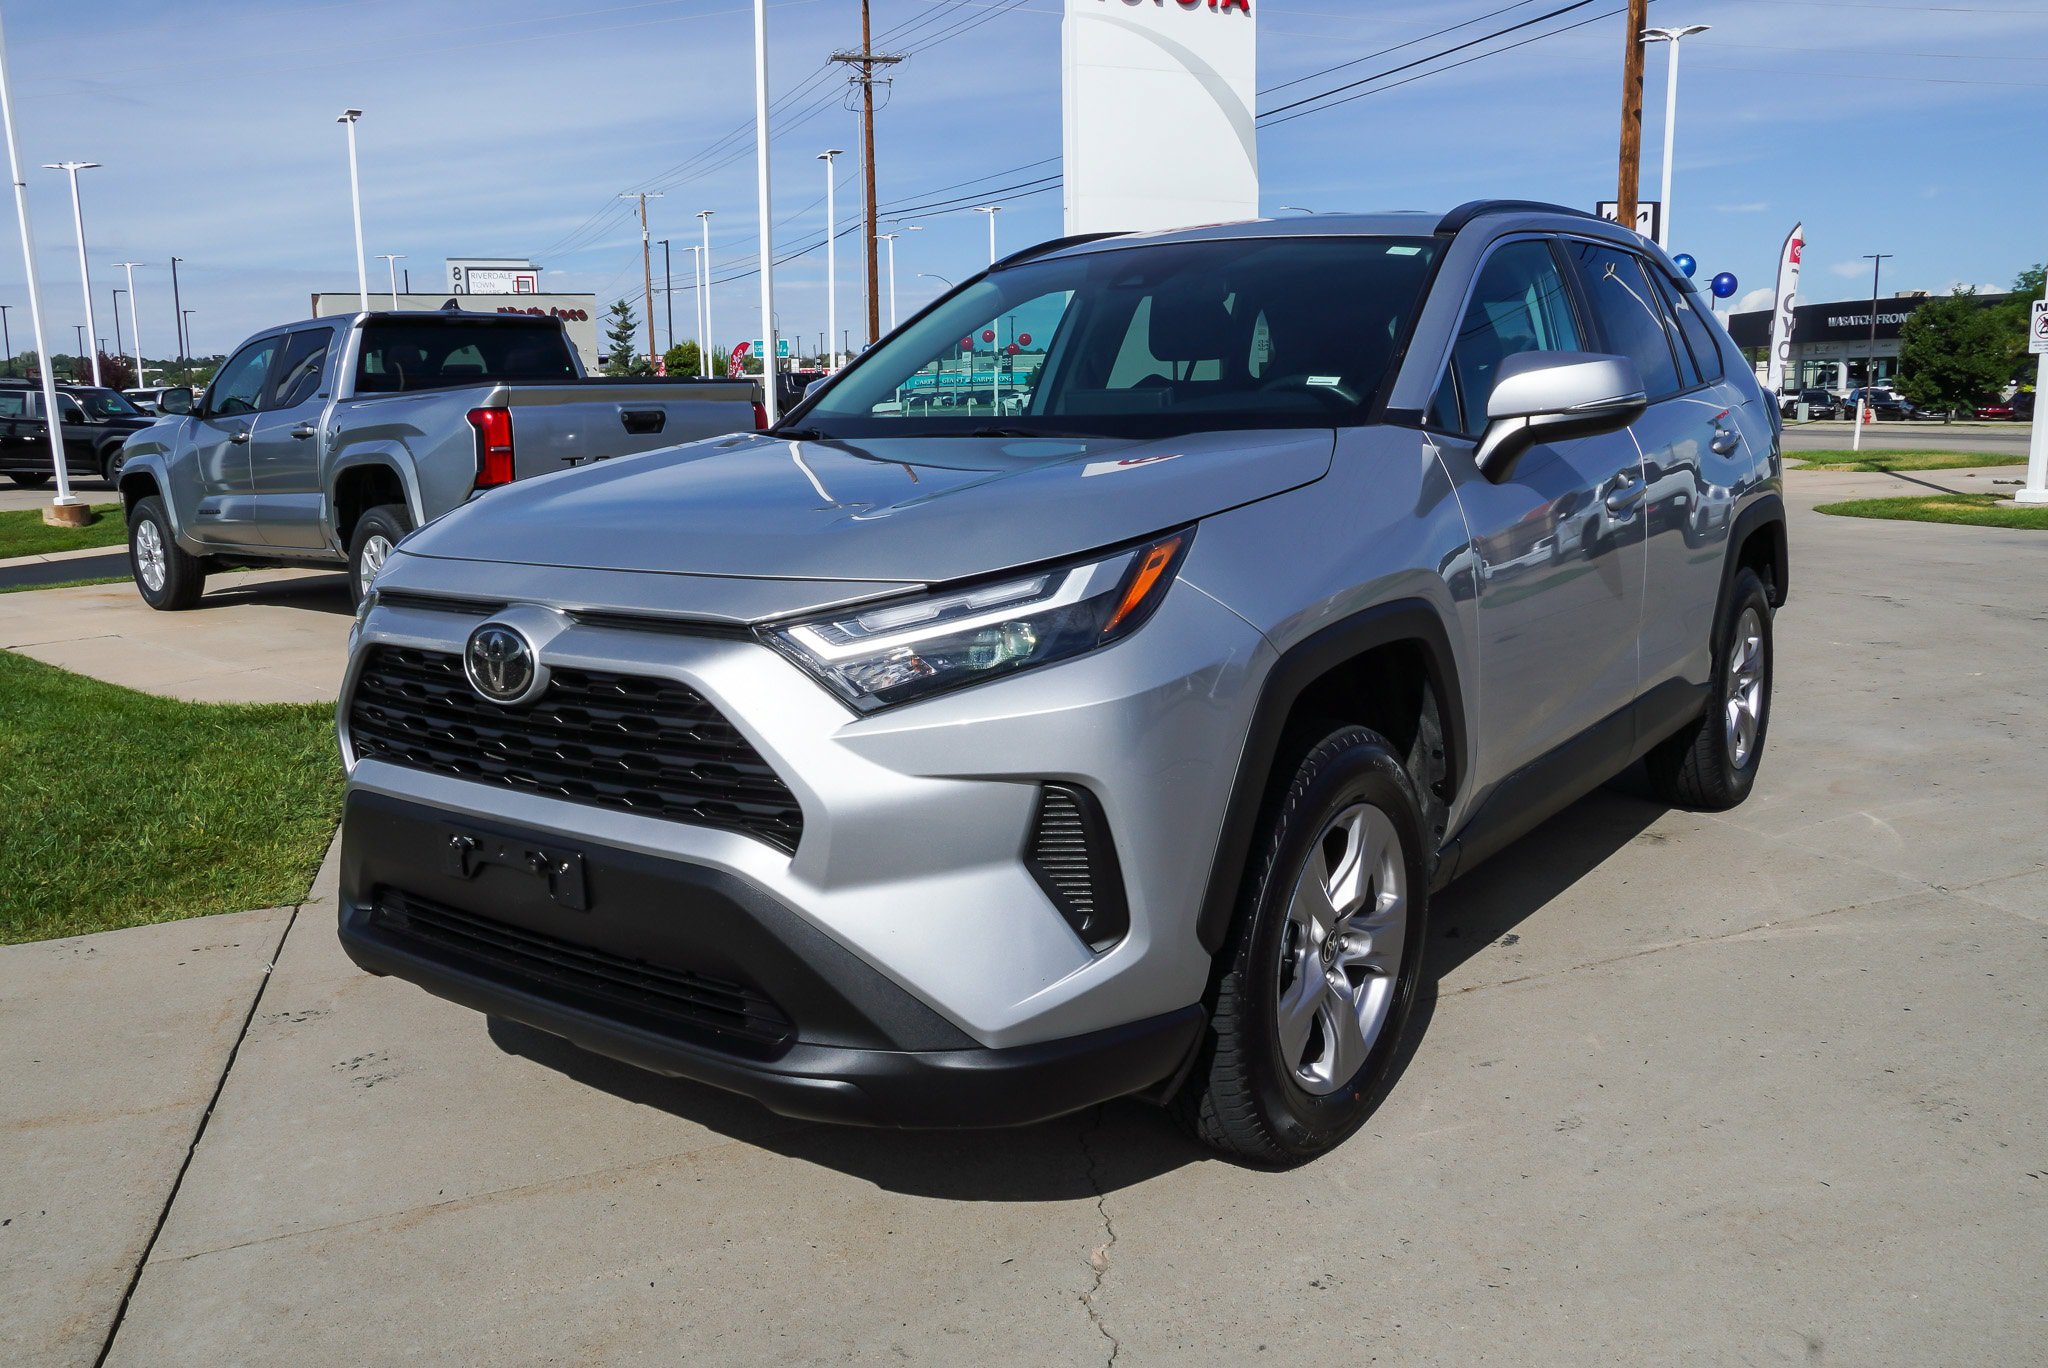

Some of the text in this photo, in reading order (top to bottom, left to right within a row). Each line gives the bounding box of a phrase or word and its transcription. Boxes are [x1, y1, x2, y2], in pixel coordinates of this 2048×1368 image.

[470, 272, 513, 280] RIVERDALE
[1828, 312, 1916, 327] WASATCH FRON
